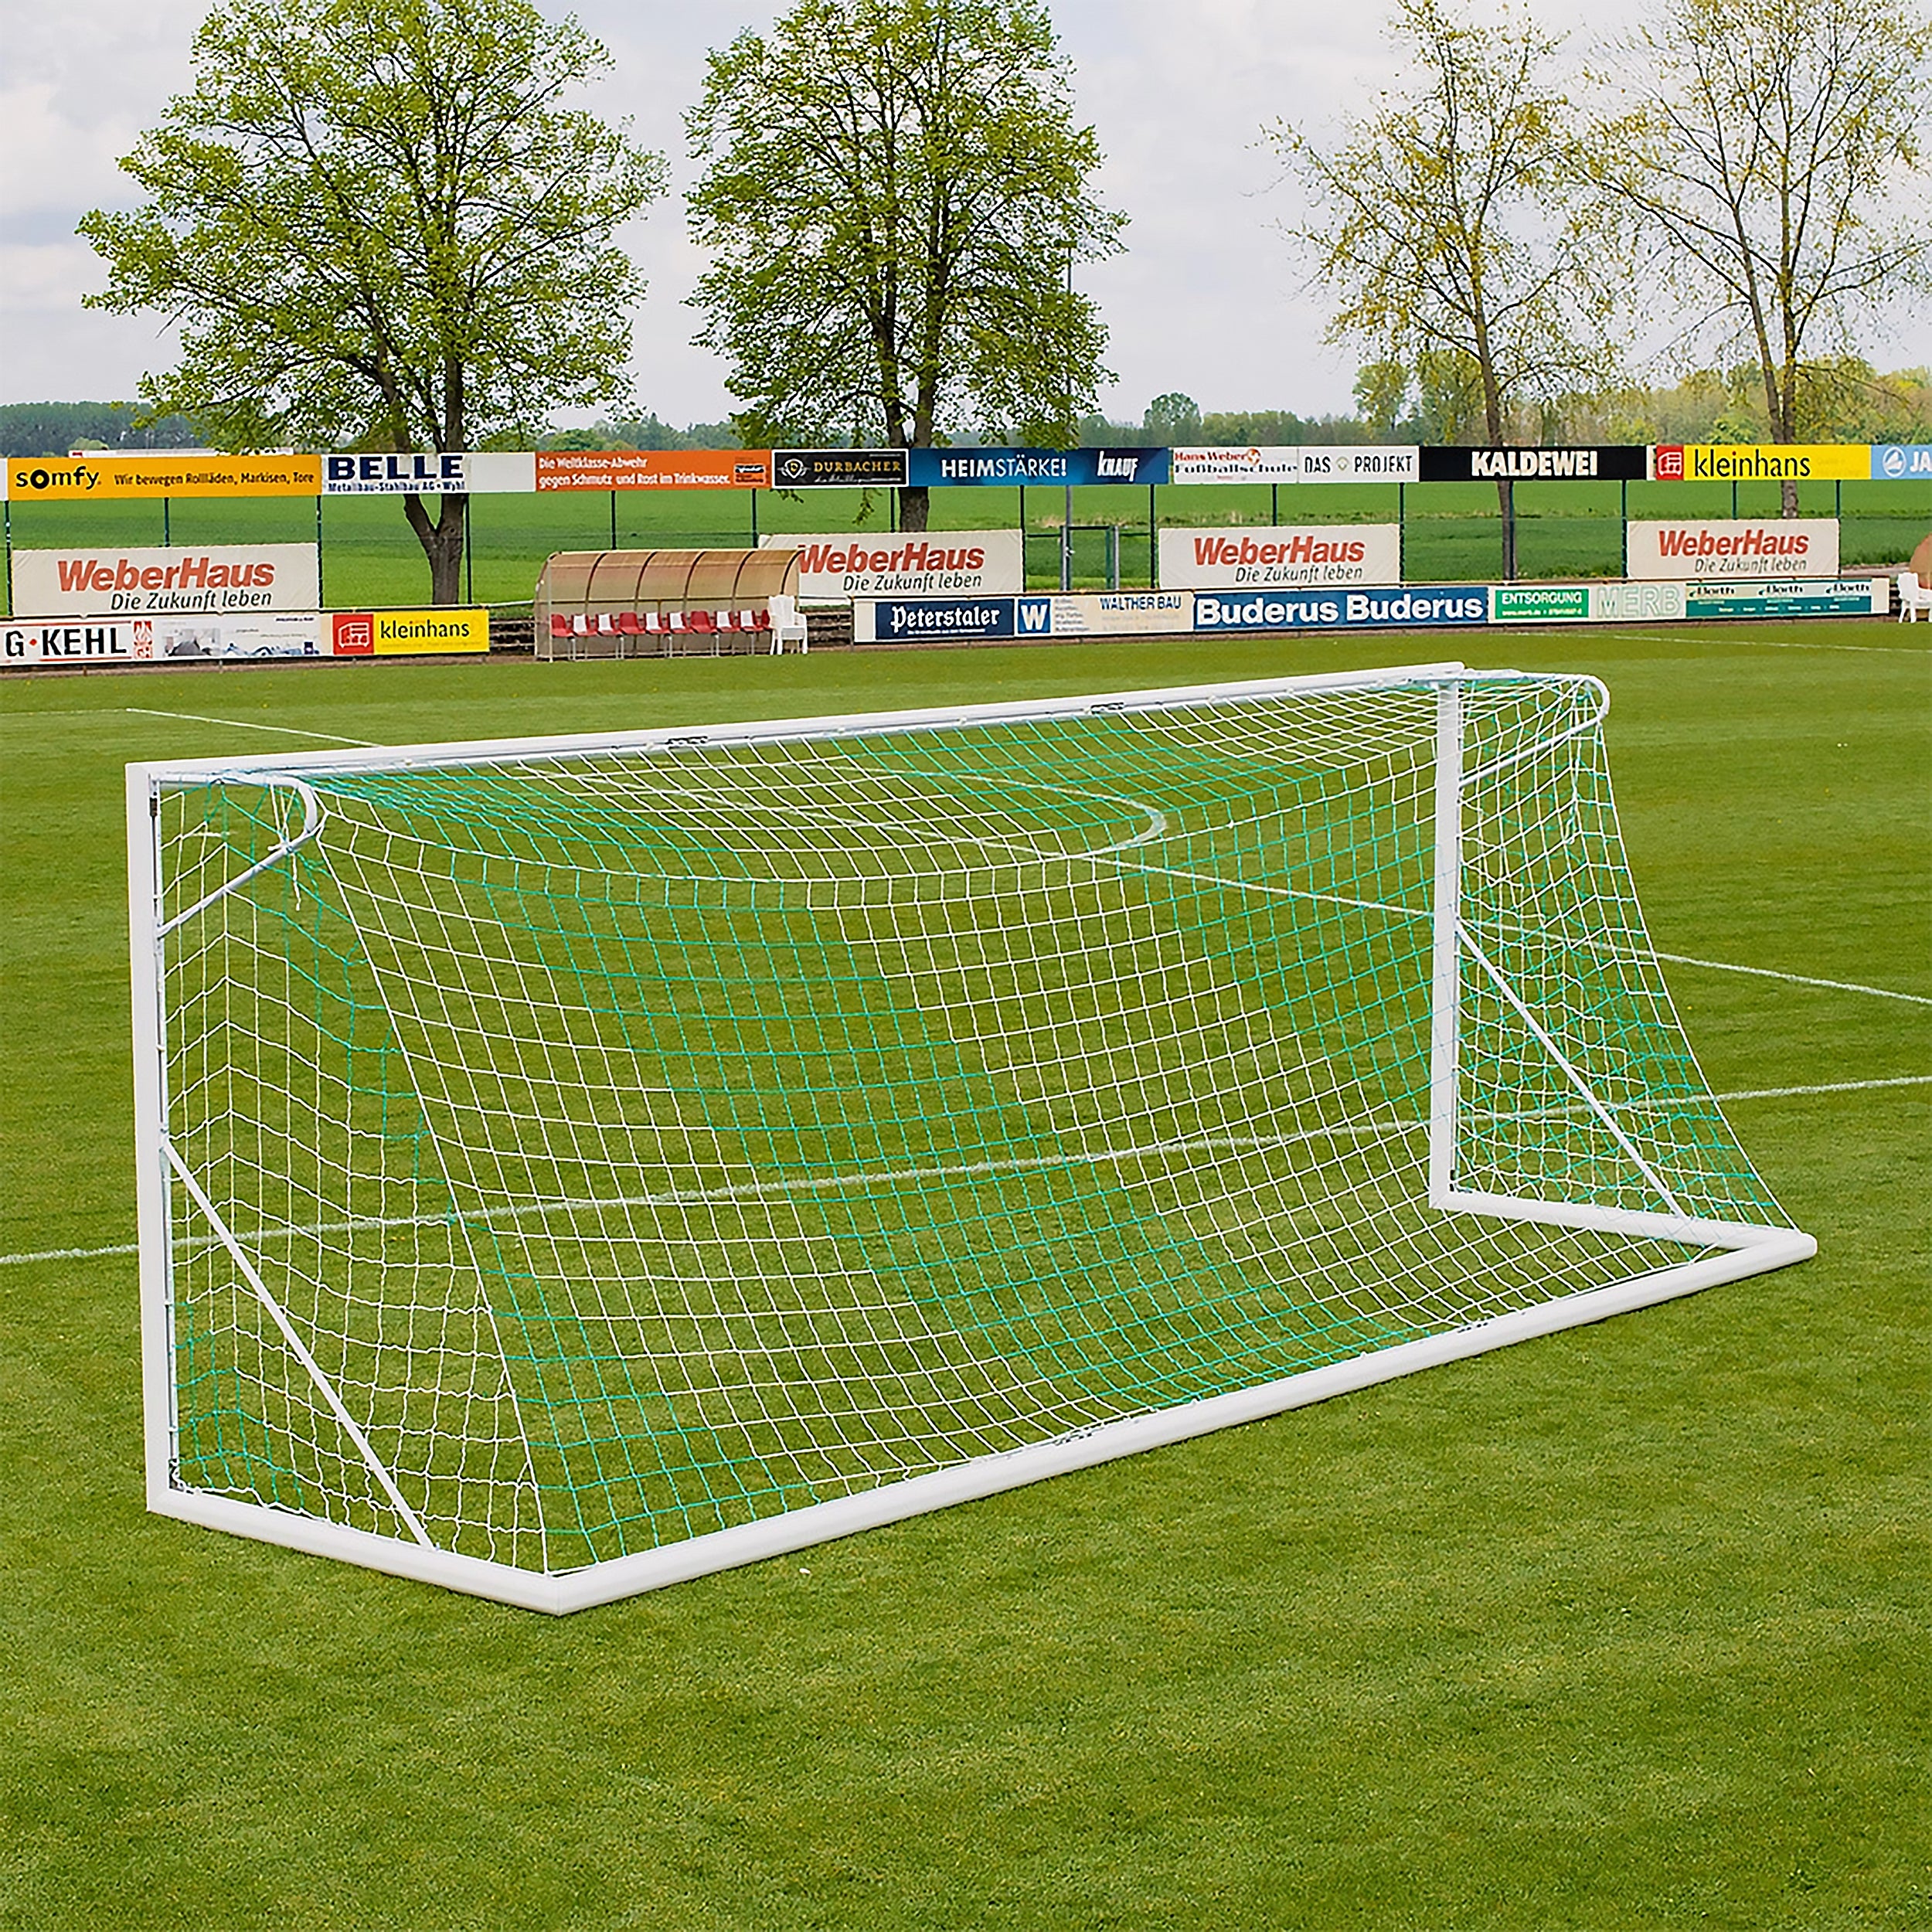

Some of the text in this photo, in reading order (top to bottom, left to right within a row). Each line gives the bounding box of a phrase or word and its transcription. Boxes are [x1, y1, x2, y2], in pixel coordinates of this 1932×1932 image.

[539, 456, 648, 469] Die Weltklasse-Abwehr
[814, 461, 902, 473] DURBACHER
[941, 454, 1067, 478] HEIMSTÄRKE!
[1174, 449, 1247, 462] Hans Weber
[1304, 454, 1413, 474] DAS PROJEKT
[1471, 451, 1597, 477] KALDEWEI
[1695, 448, 1811, 477] kleinhans
[15, 465, 100, 490] somfy
[114, 474, 133, 485] Wir
[135, 472, 183, 488] bewegen
[241, 471, 291, 485] Markisen,
[293, 471, 315, 483] Tore
[328, 455, 464, 481] BELLE
[539, 475, 571, 489] gegen
[571, 473, 613, 485] Schmutz
[616, 473, 635, 485] und
[638, 473, 658, 485] Rost
[659, 472, 673, 484] im
[1194, 536, 1366, 566] WeberHaus
[1658, 529, 1809, 556] WeberHaus
[798, 542, 985, 573] WeberHaus
[1695, 556, 1807, 574] Die Zukunft leben
[57, 557, 275, 592] WeberHaus
[843, 573, 981, 593] Die Zukunft leben
[1236, 564, 1362, 583] Die Zukunft leben
[111, 590, 273, 611] Die Zukunft leben
[1100, 596, 1182, 611] WALTHER BAU
[1346, 593, 1484, 621] Buderus
[1502, 591, 1583, 605] ENTSORGUNG
[1597, 585, 1682, 618] MERB
[889, 605, 1000, 633] Peterstaler
[1021, 604, 1048, 631] W
[1196, 597, 1339, 626] Buderus
[380, 619, 470, 639] kleinhans
